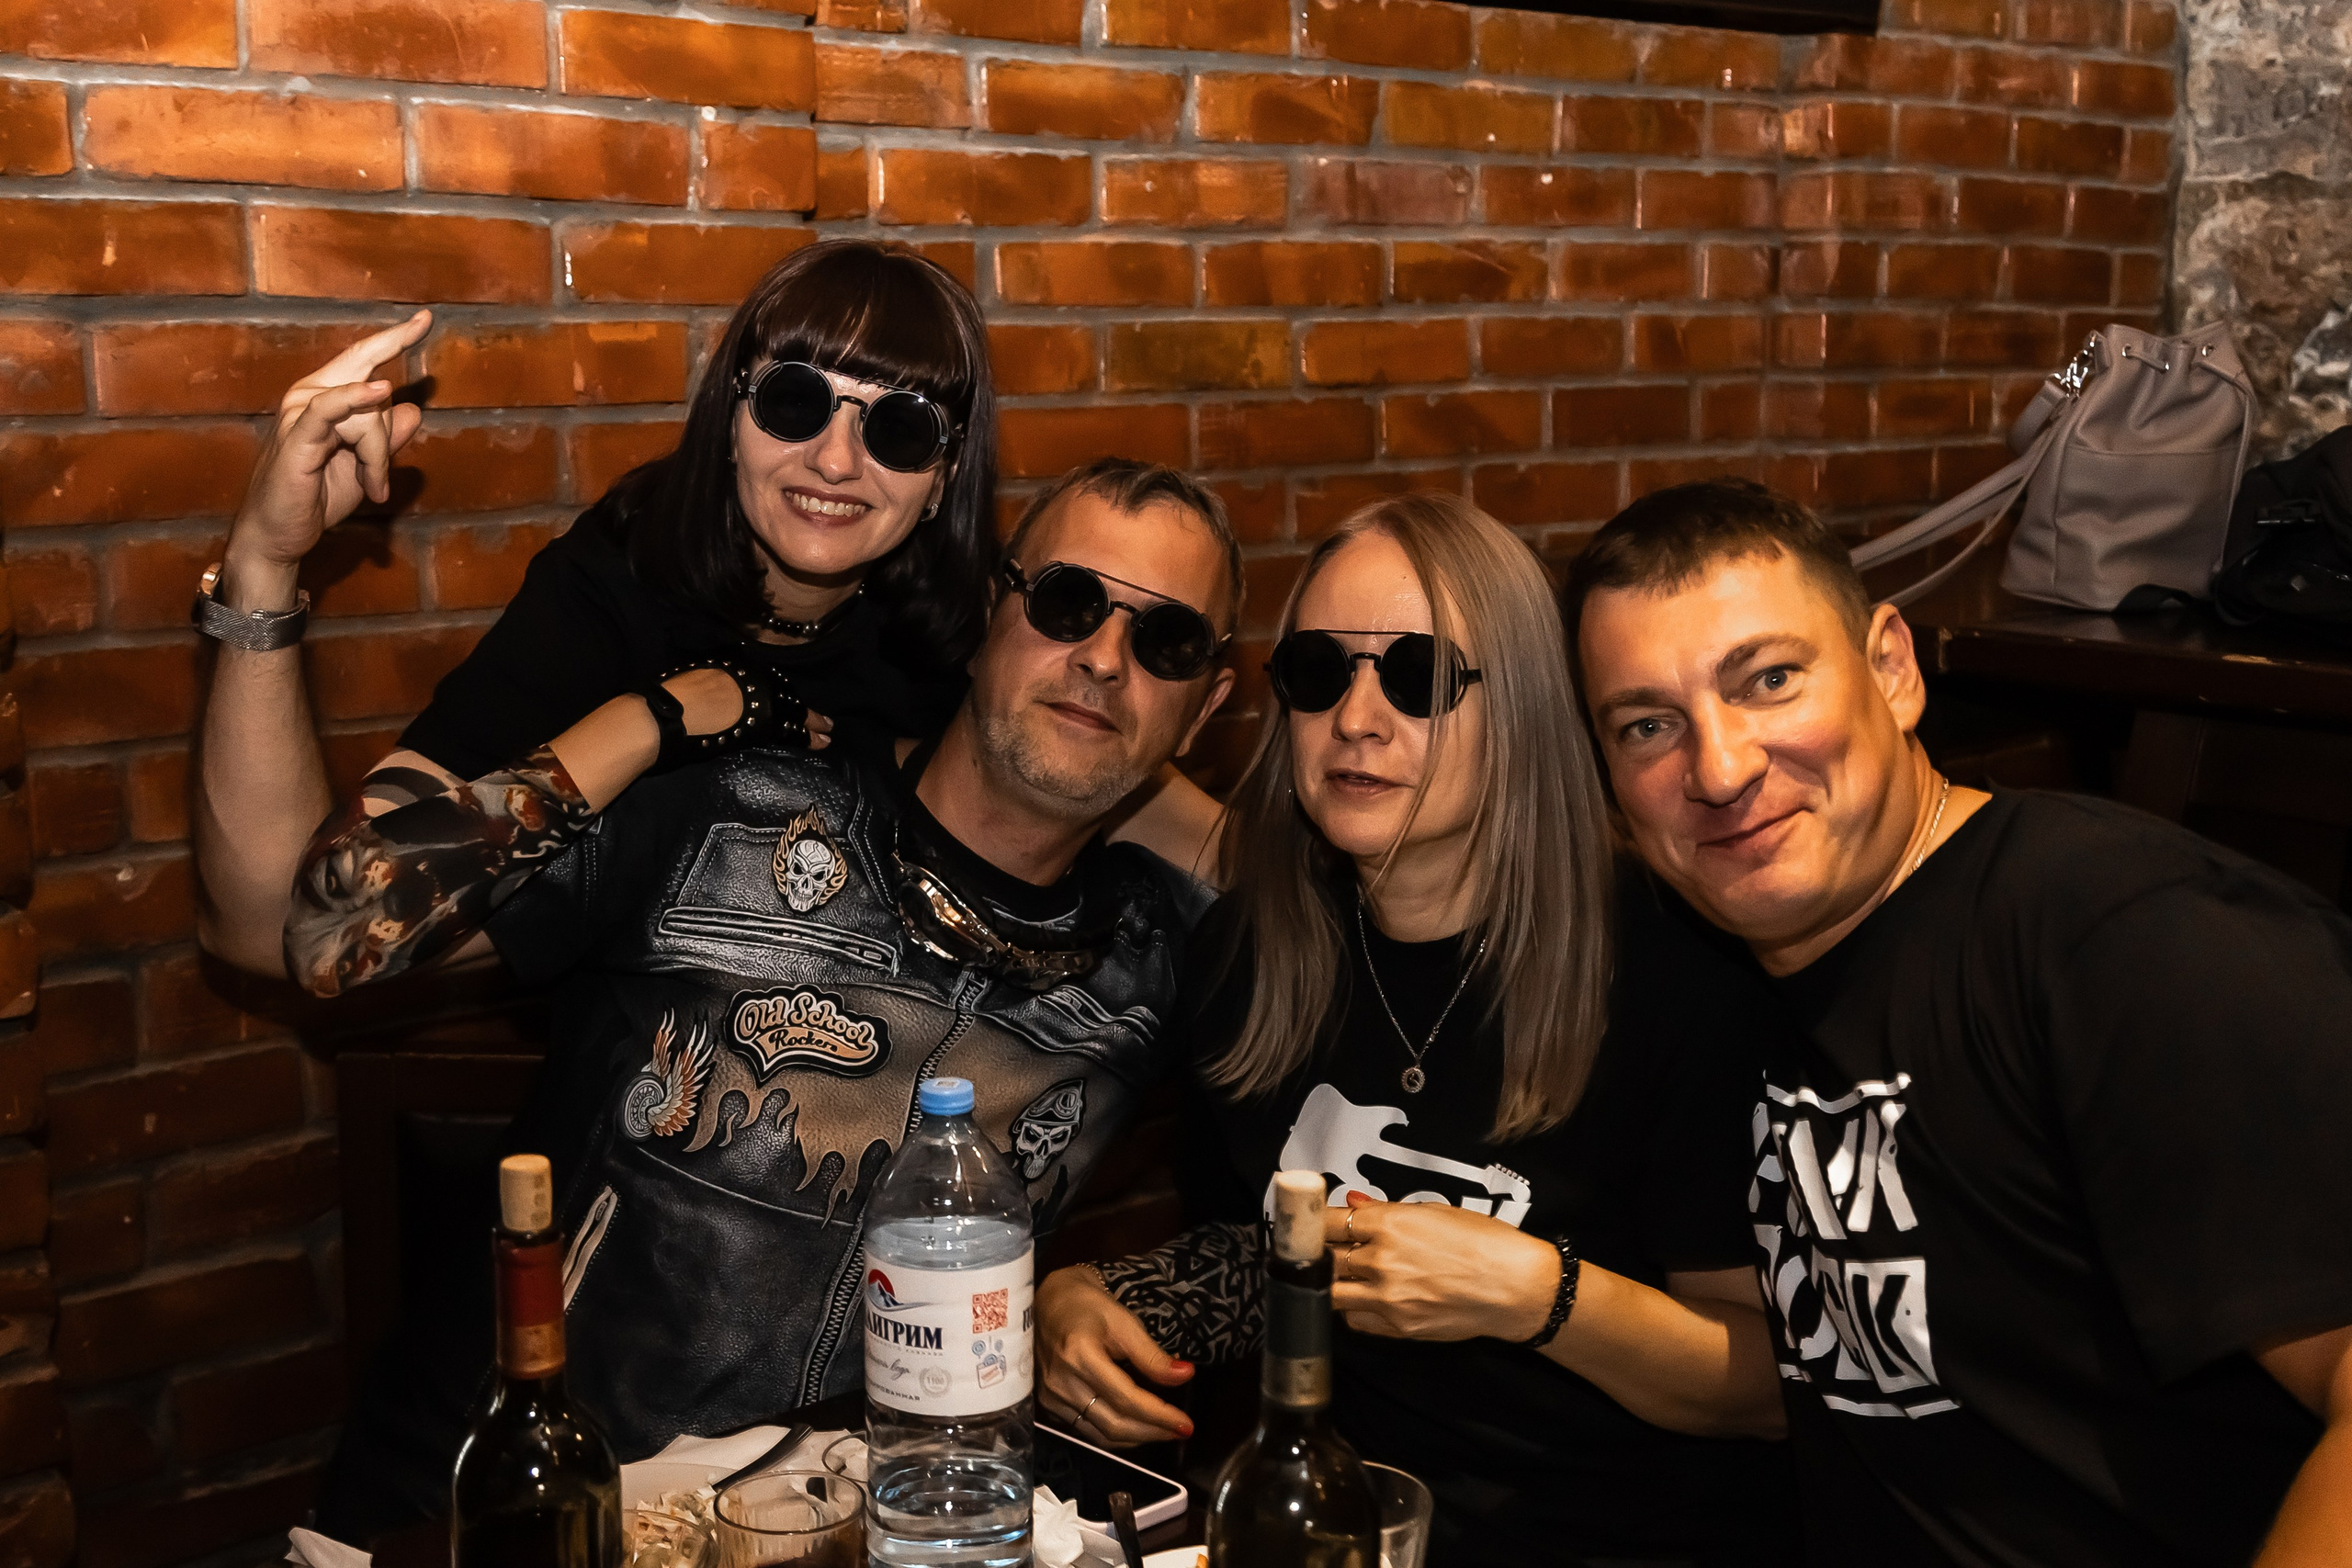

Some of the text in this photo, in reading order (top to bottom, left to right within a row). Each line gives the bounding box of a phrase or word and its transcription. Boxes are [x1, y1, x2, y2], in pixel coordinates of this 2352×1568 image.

[739, 994, 874, 1051] Old School
[865, 1307, 944, 1350] ЛИГРИМ
